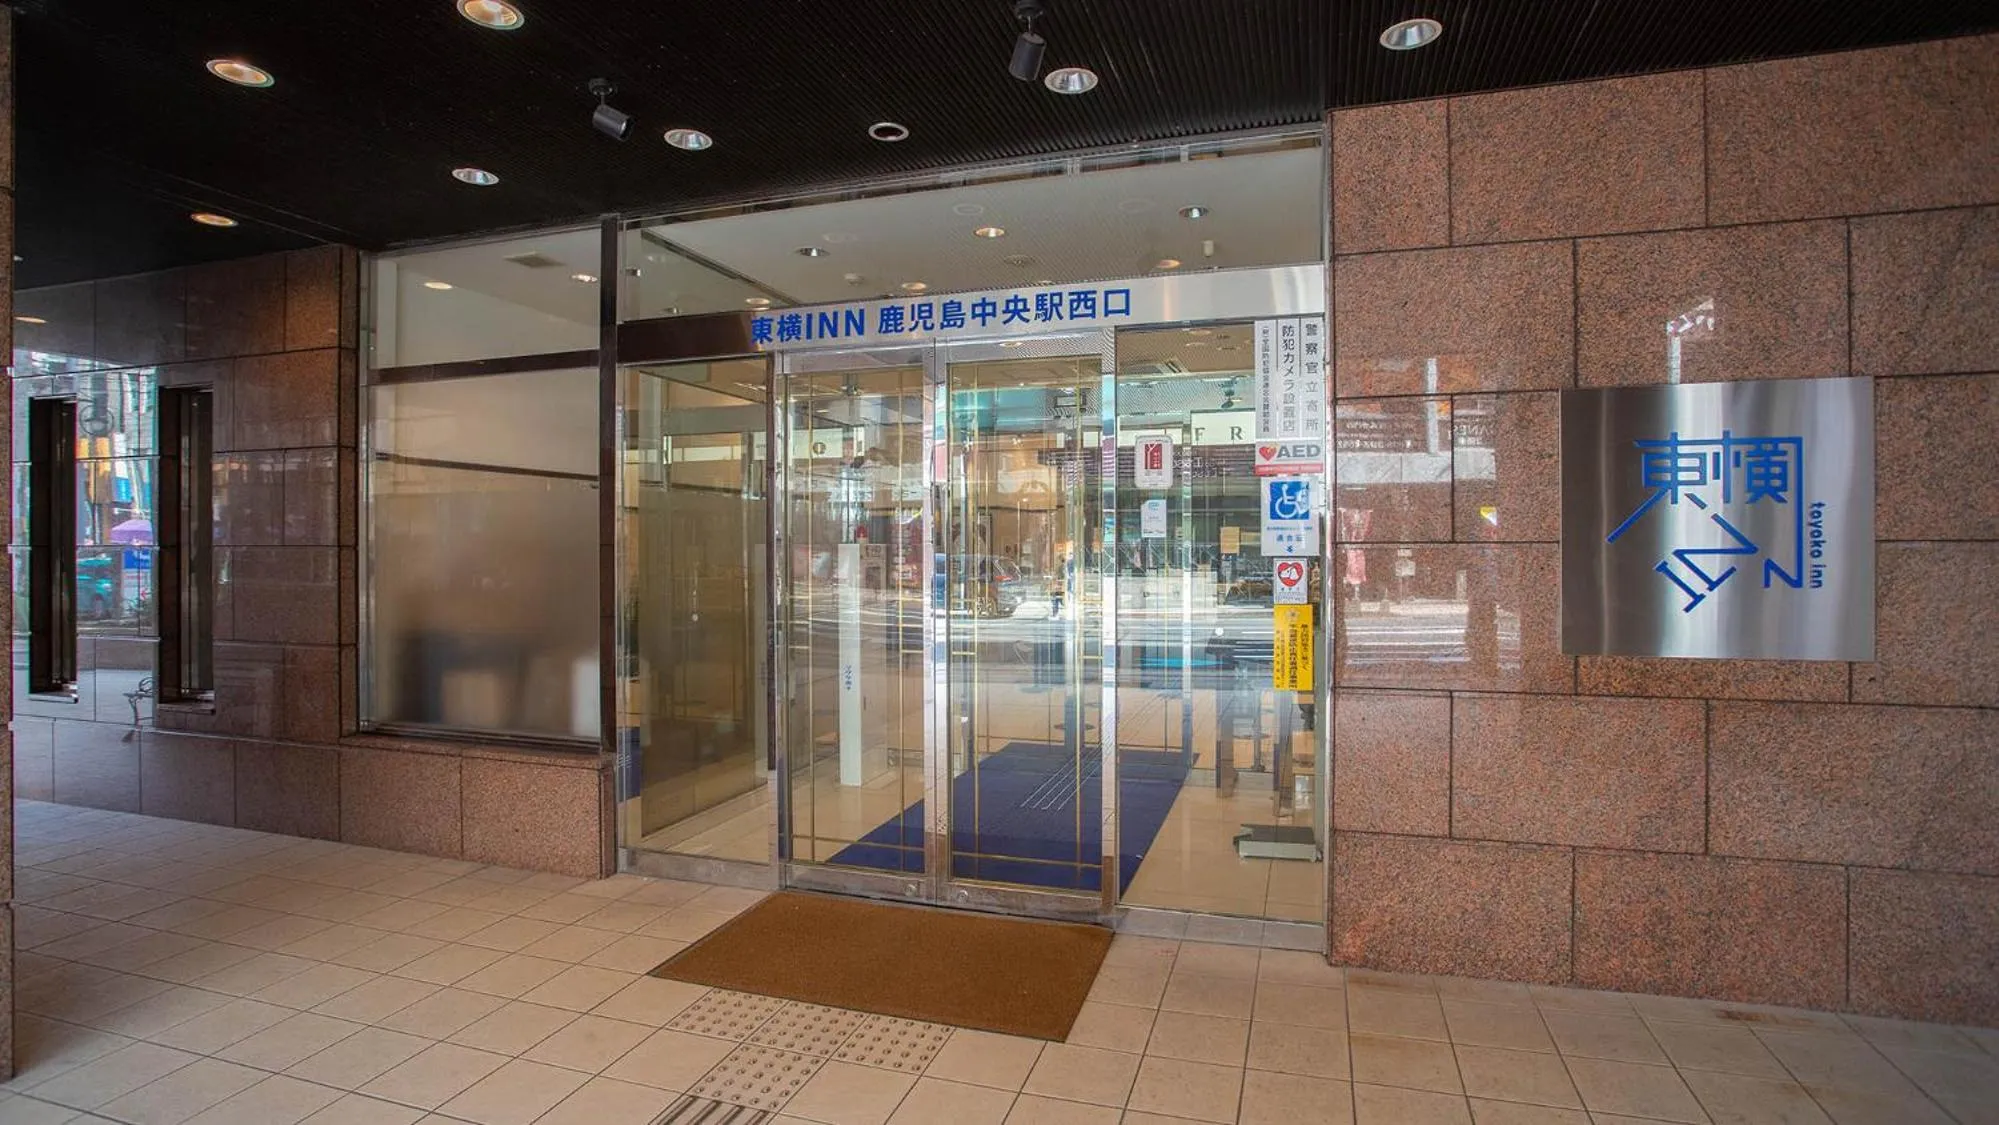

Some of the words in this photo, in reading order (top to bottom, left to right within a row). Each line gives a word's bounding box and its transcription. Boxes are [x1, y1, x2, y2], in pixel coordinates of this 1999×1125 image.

[752, 308, 864, 344] 東横INN
[878, 289, 1130, 334] 鹿児島中央駅西口
[1282, 325, 1295, 431] 防犯カメラ設置店
[1277, 445, 1321, 458] AED
[1807, 502, 1826, 558] toyoko
[1809, 564, 1827, 589] inn
